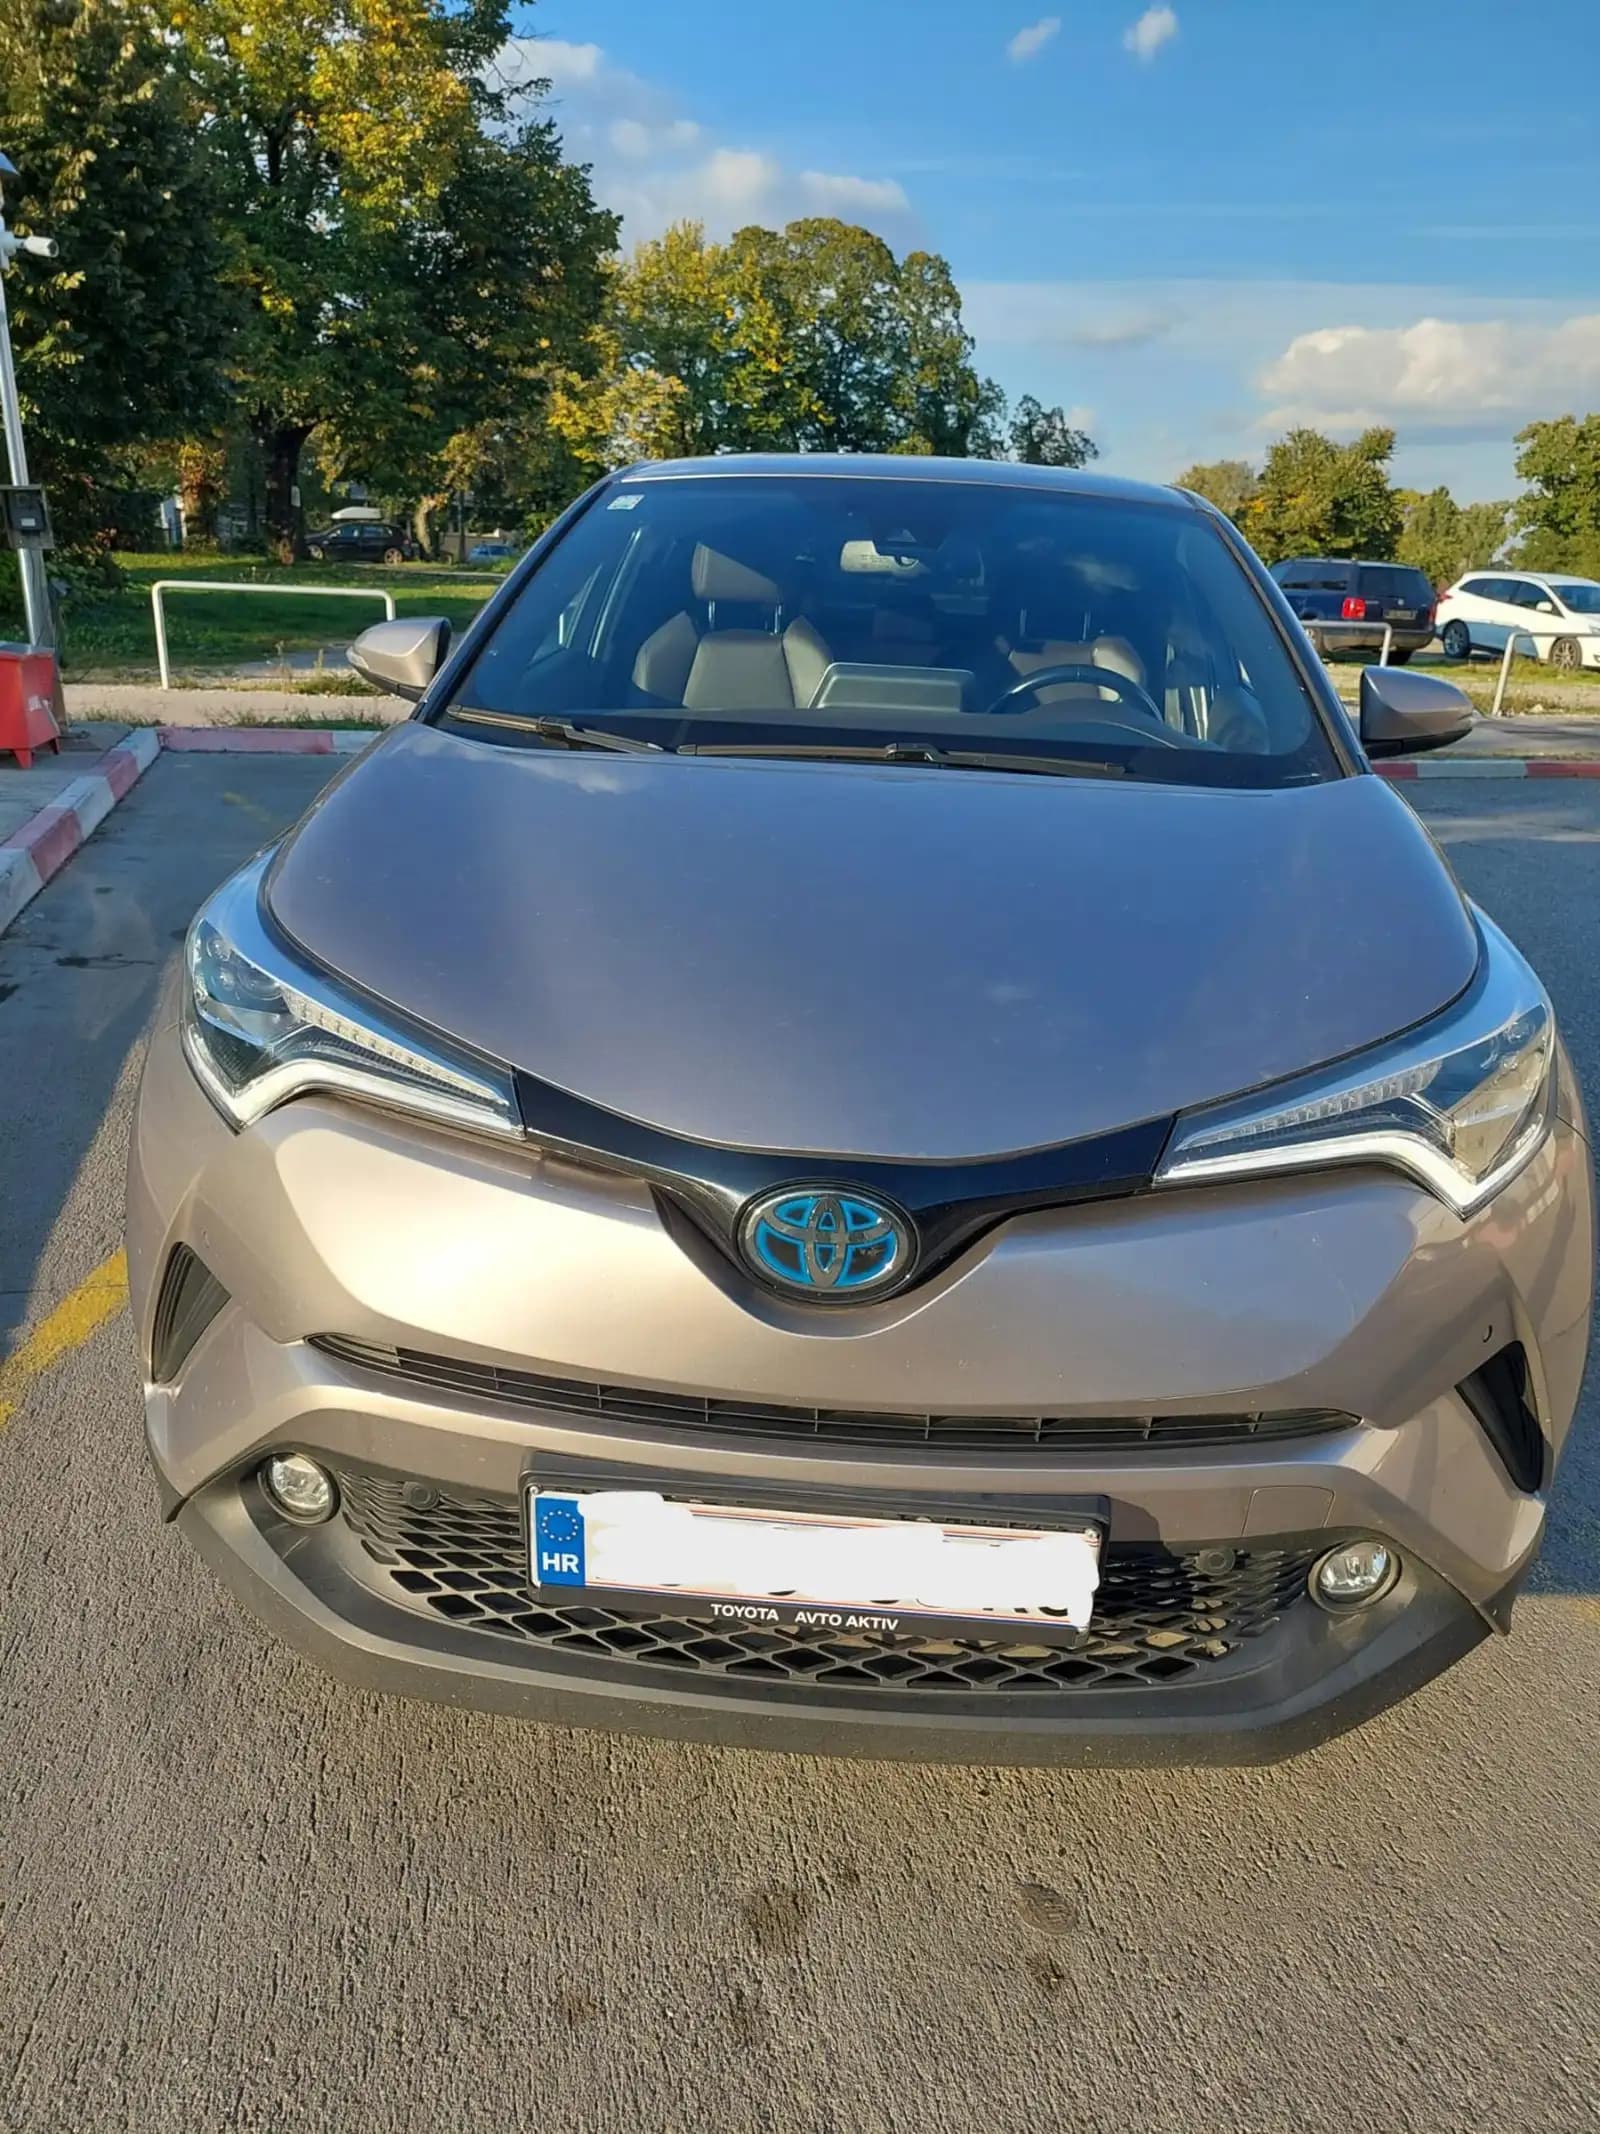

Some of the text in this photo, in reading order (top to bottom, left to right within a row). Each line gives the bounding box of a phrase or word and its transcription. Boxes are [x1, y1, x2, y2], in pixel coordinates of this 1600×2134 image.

[542, 1551, 580, 1574] HR
[710, 1603, 899, 1631] TOYOTA AVTO AKTIV
